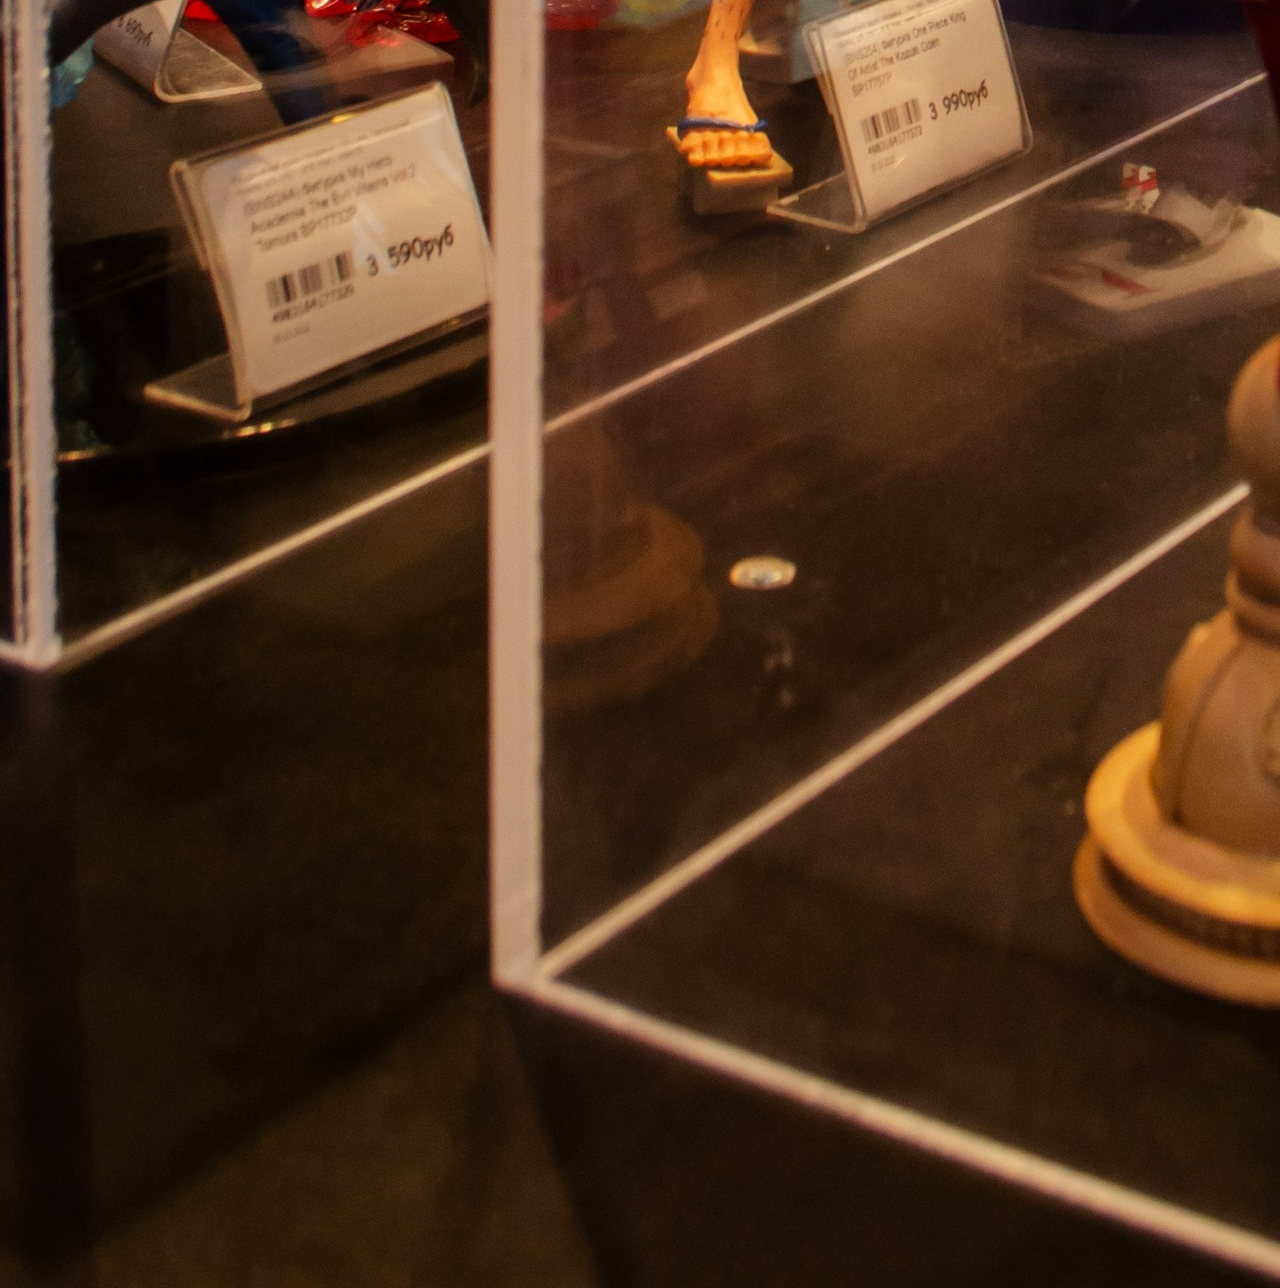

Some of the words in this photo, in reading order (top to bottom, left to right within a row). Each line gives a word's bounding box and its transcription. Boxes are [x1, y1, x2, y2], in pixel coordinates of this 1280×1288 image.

[912, 25, 928, 38] One
[929, 16, 949, 32] Piece
[949, 11, 967, 25] King
[879, 54, 895, 68] The
[928, 102, 939, 121] 3
[942, 79, 989, 115] 990руб
[365, 253, 380, 278] 3
[386, 223, 454, 270] 590руб
